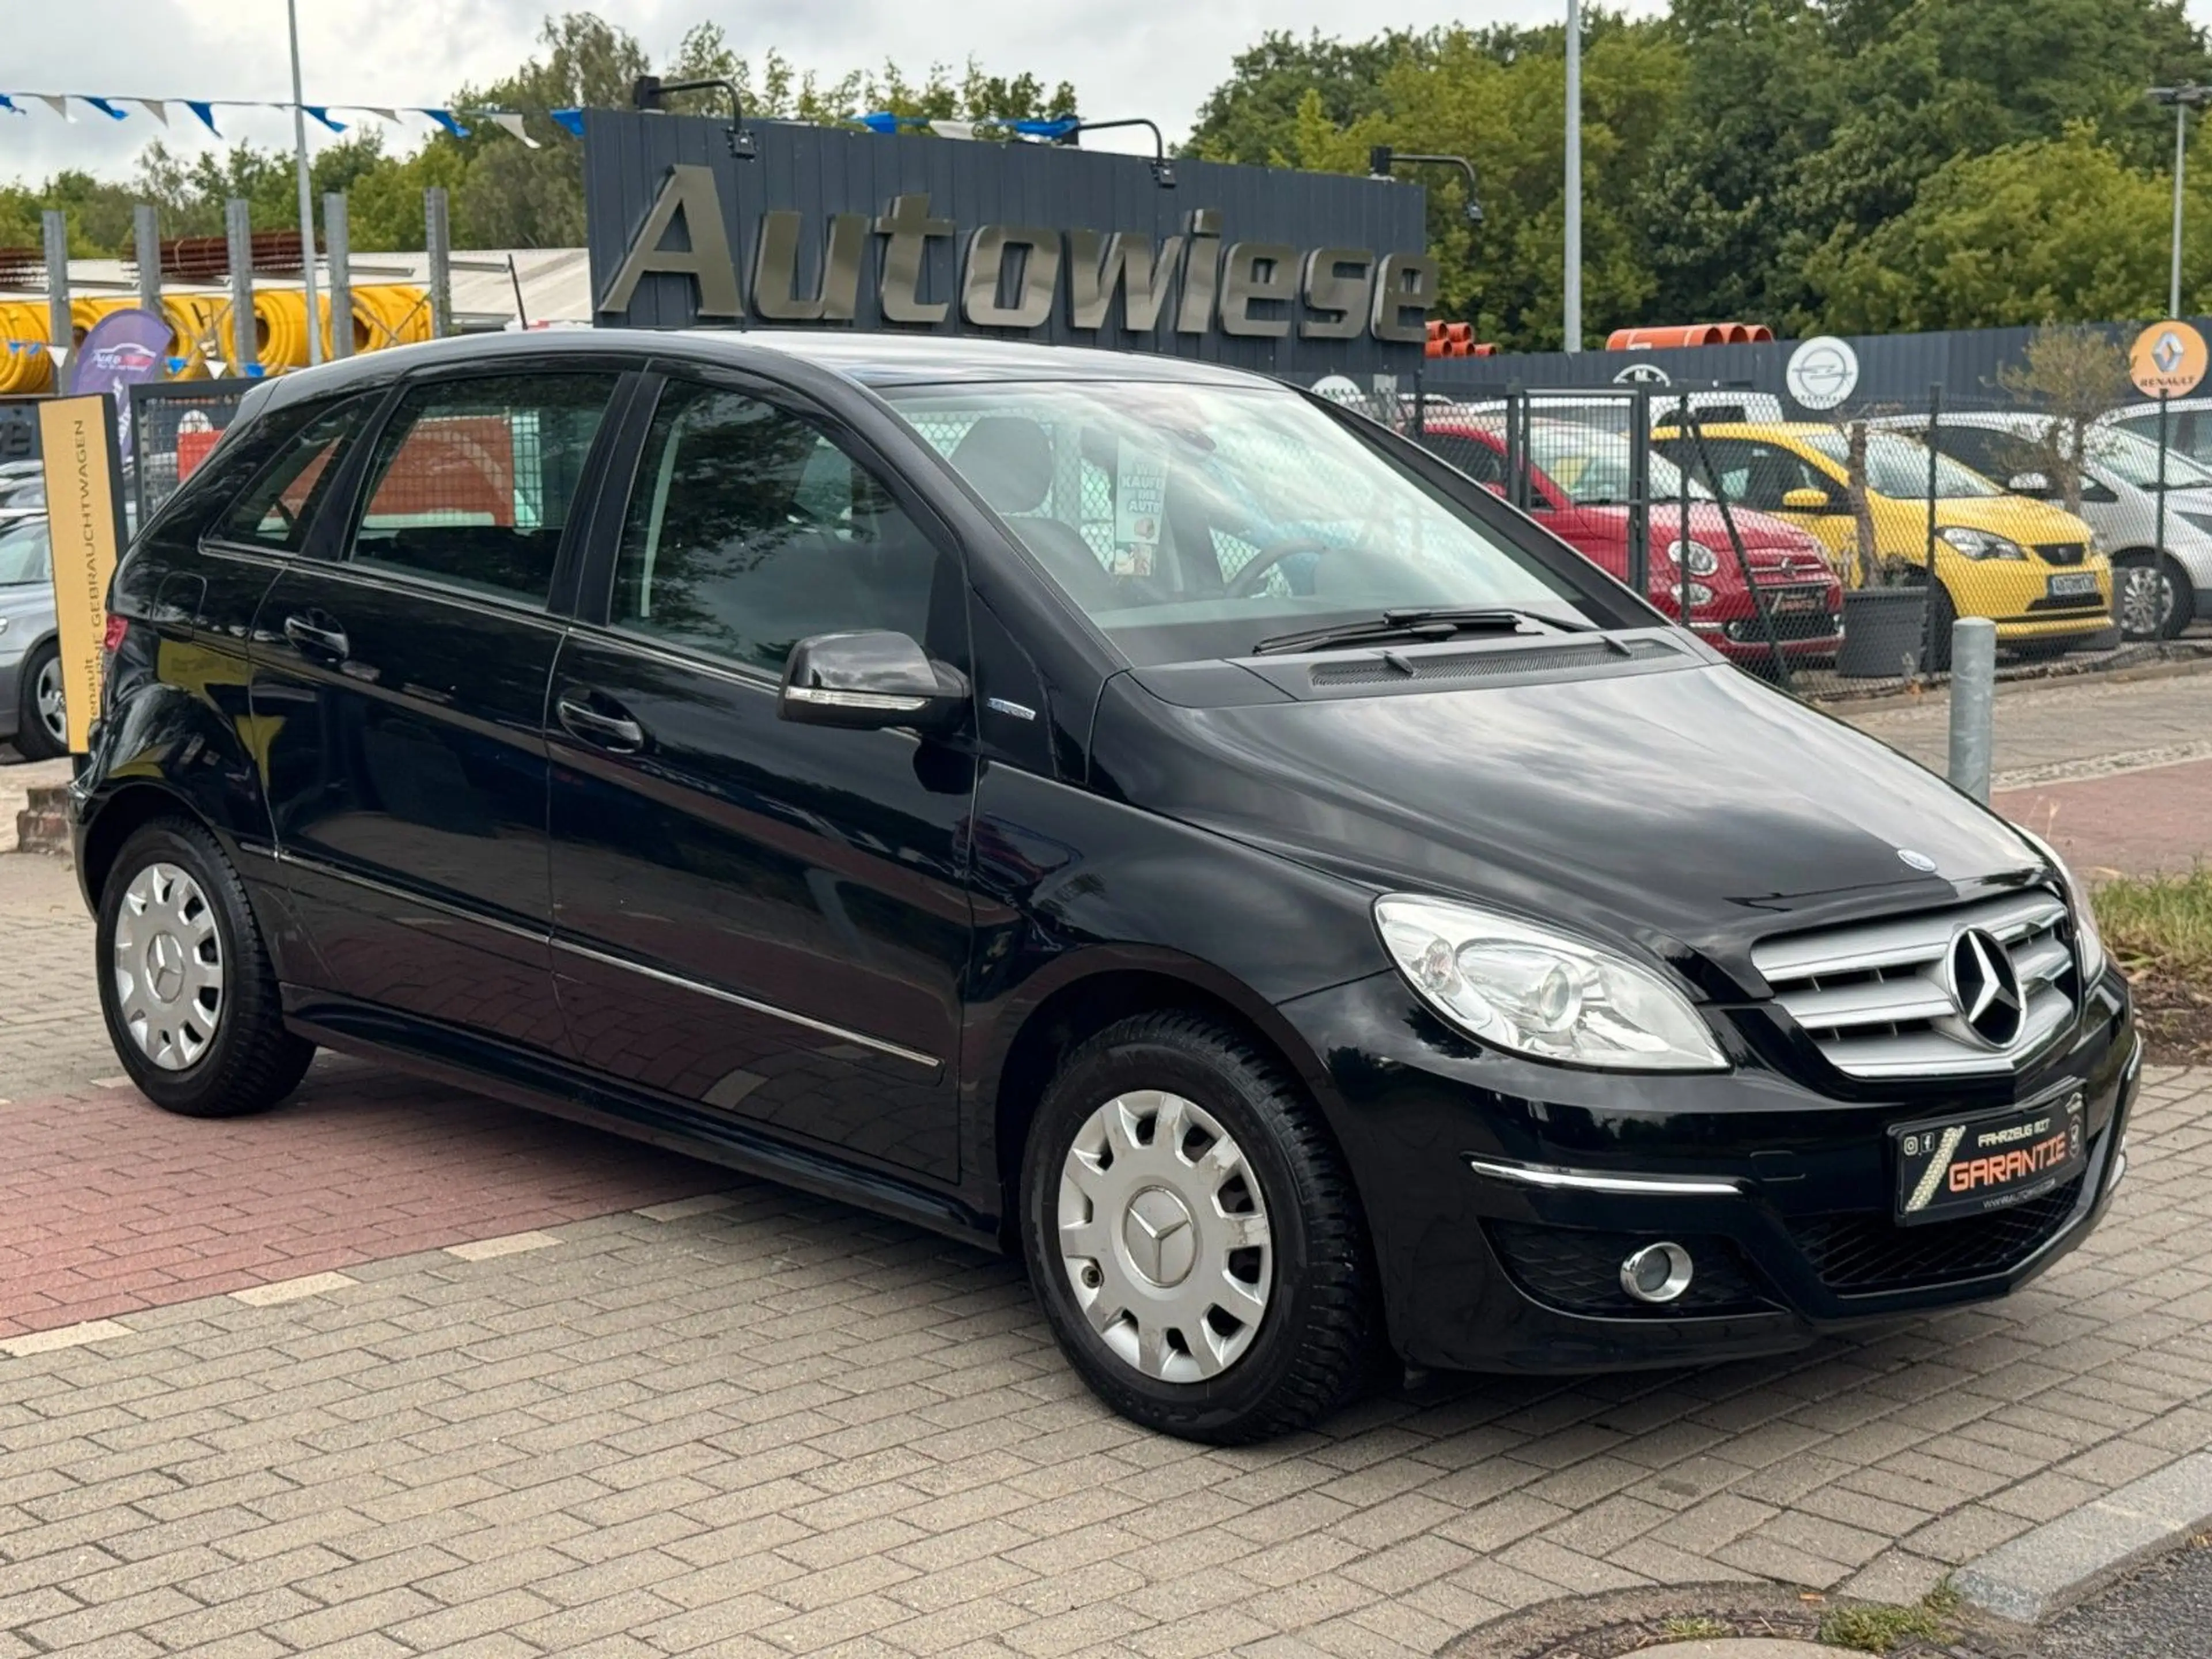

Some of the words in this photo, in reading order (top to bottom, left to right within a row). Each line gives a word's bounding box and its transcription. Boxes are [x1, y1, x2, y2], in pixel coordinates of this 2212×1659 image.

[598, 164, 1439, 342] Autowiese
[2140, 376, 2195, 387] RENAULT
[73, 419, 102, 627] GEBRAUCHTWAGEN
[1949, 1131, 2066, 1192] GARANTIE
[1978, 1123, 2033, 1147] FAHRZEUG
[2033, 1118, 2051, 1134] MIT
